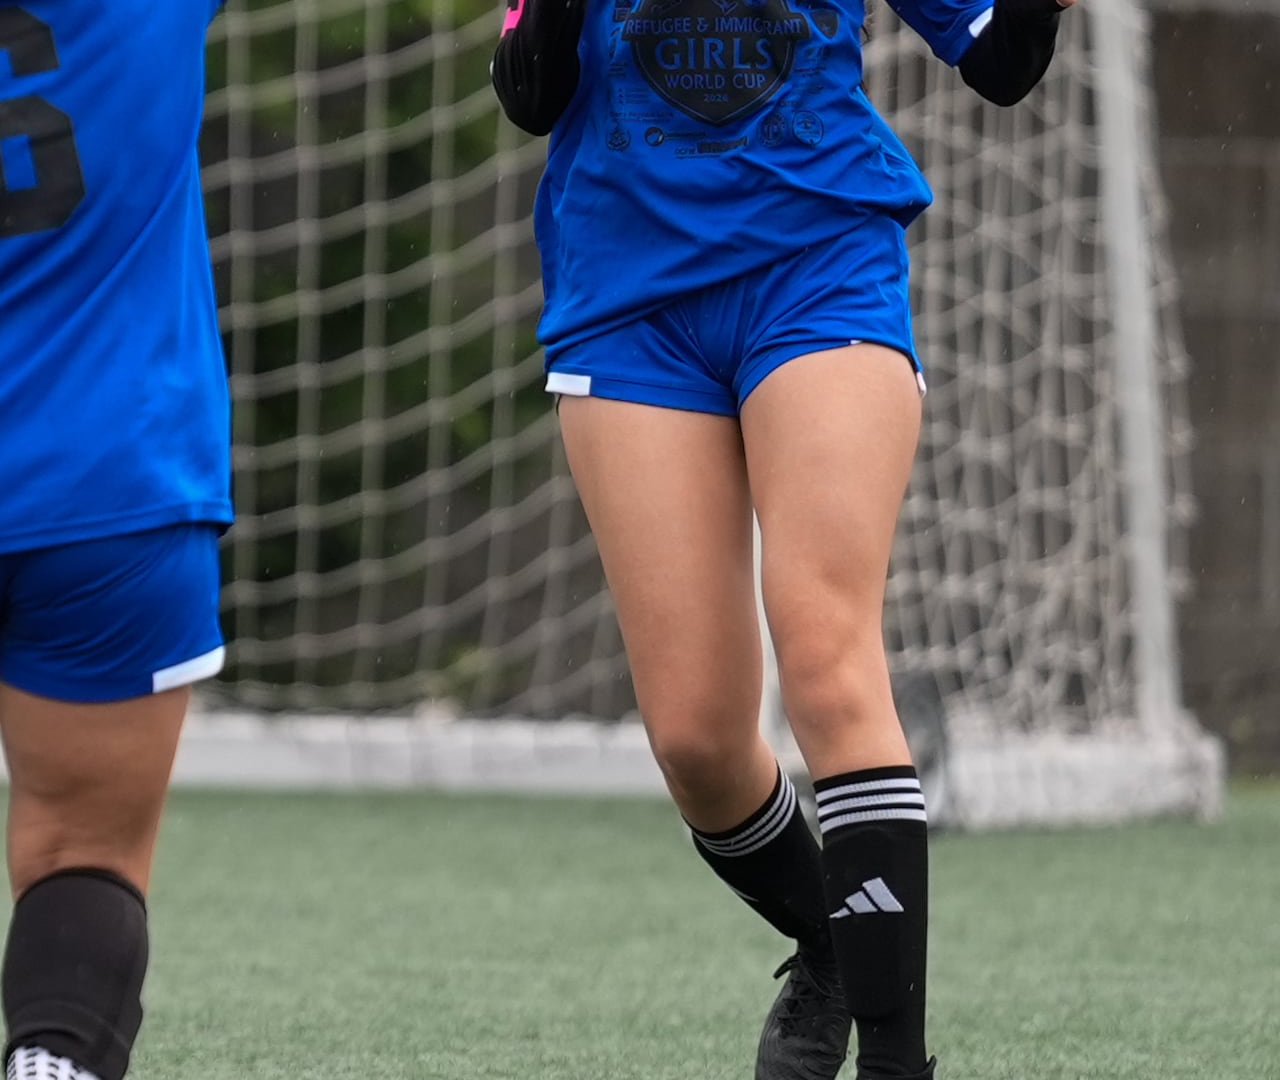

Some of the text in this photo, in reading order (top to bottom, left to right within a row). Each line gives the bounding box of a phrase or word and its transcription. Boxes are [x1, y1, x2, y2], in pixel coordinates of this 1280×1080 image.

[626, 17, 802, 35] REFUGEE & IMMIGRANT
[655, 37, 774, 70] GIRLS
[664, 73, 766, 90] WORLD CUP
